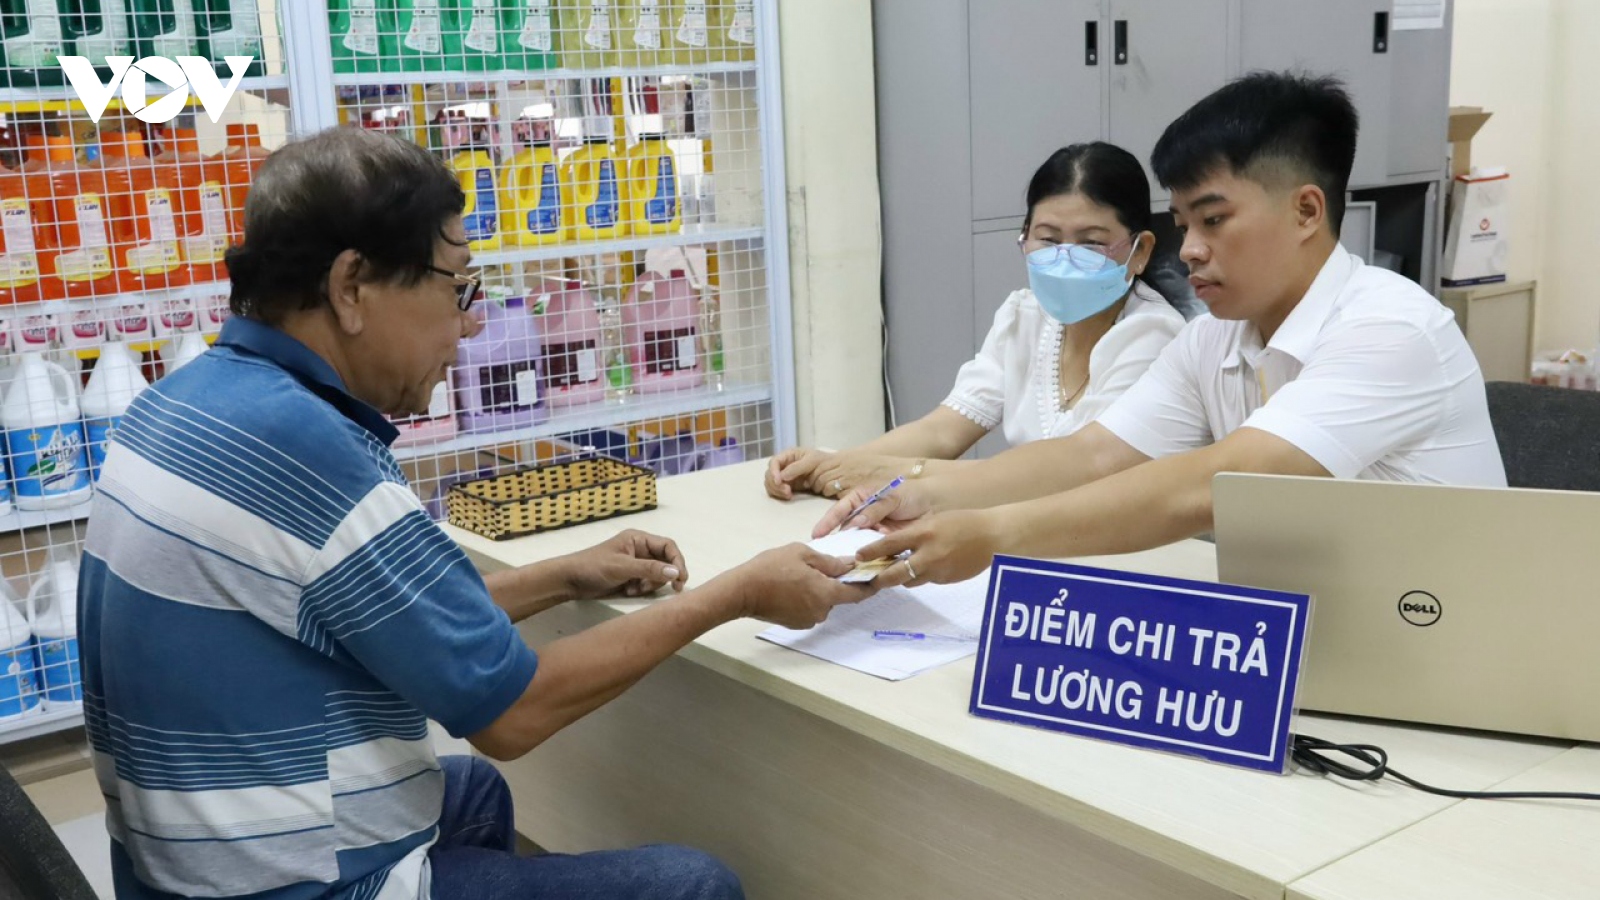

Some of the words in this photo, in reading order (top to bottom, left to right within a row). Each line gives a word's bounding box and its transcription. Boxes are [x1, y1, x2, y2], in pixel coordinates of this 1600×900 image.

[1004, 588, 1097, 649] ĐIỂM
[1108, 616, 1176, 661] CHI
[1189, 621, 1269, 677] TRẢ
[1403, 603, 1437, 614] DELL
[1011, 662, 1143, 720] LƯƠNG
[1155, 687, 1243, 737] HƯU
